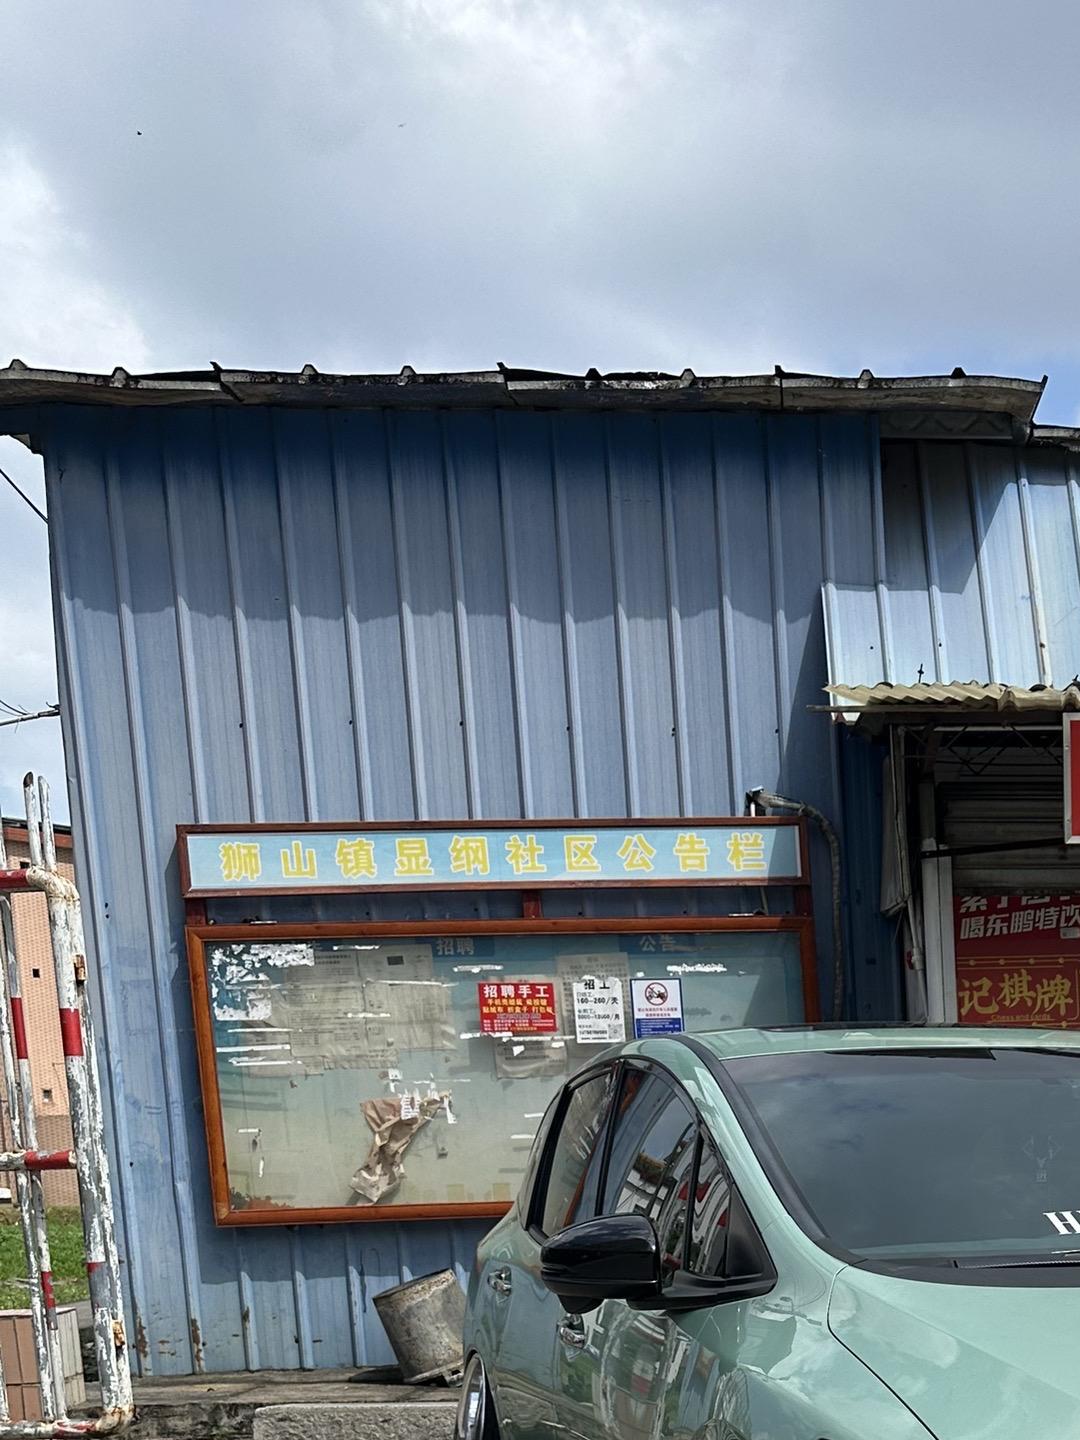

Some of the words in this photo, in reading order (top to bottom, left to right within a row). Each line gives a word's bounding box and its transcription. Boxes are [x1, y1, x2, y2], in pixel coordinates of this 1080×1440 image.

[219, 833, 768, 881] 狮山镇显纲社区公告栏
[436, 936, 475, 955] 招聘
[640, 933, 676, 952] 公告
[484, 984, 549, 998] 招聘手工
[959, 968, 1073, 1016] 记棋牌
